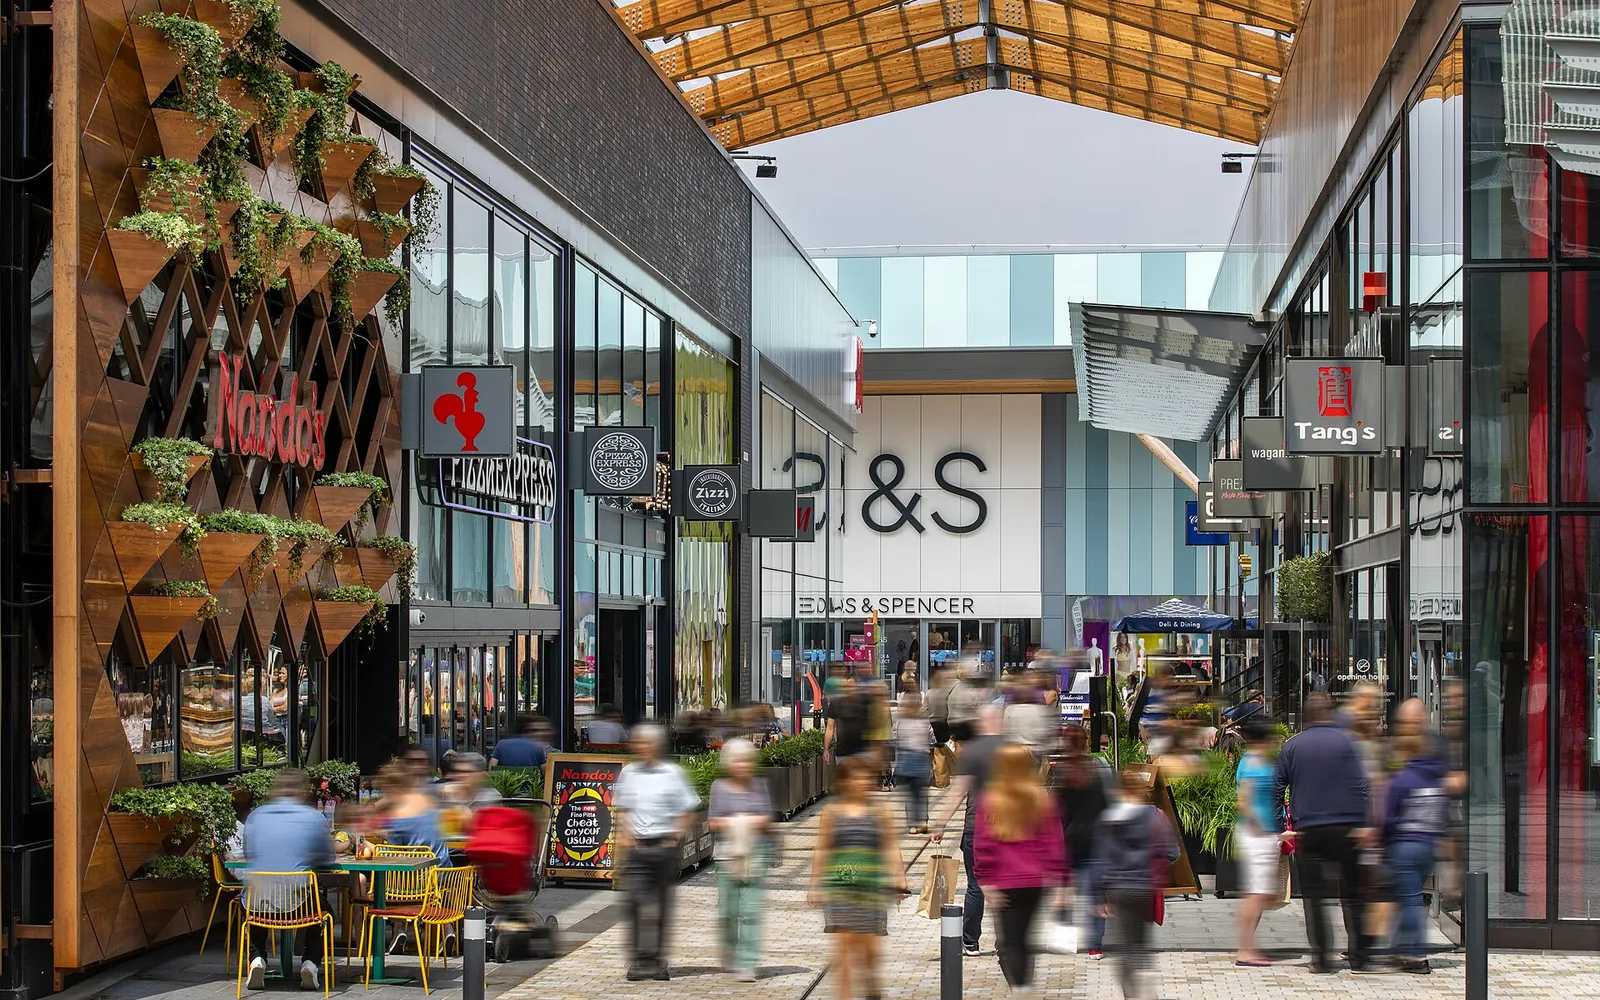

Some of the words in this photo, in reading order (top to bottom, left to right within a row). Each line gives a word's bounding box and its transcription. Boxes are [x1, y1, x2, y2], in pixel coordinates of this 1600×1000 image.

[213, 350, 326, 471] Nando's
[1293, 420, 1376, 446] Tang's
[604, 452, 635, 460] PIZZA
[695, 487, 730, 499] Zizzi
[698, 502, 727, 513] ITALIAN
[861, 597, 875, 614] &
[878, 597, 975, 614] SPENCER
[1180, 621, 1201, 629] Dining
[1337, 673, 1367, 681] opening
[561, 768, 615, 781] Nando's
[566, 817, 599, 828] Cheat
[564, 828, 577, 836] on
[577, 827, 601, 837] your
